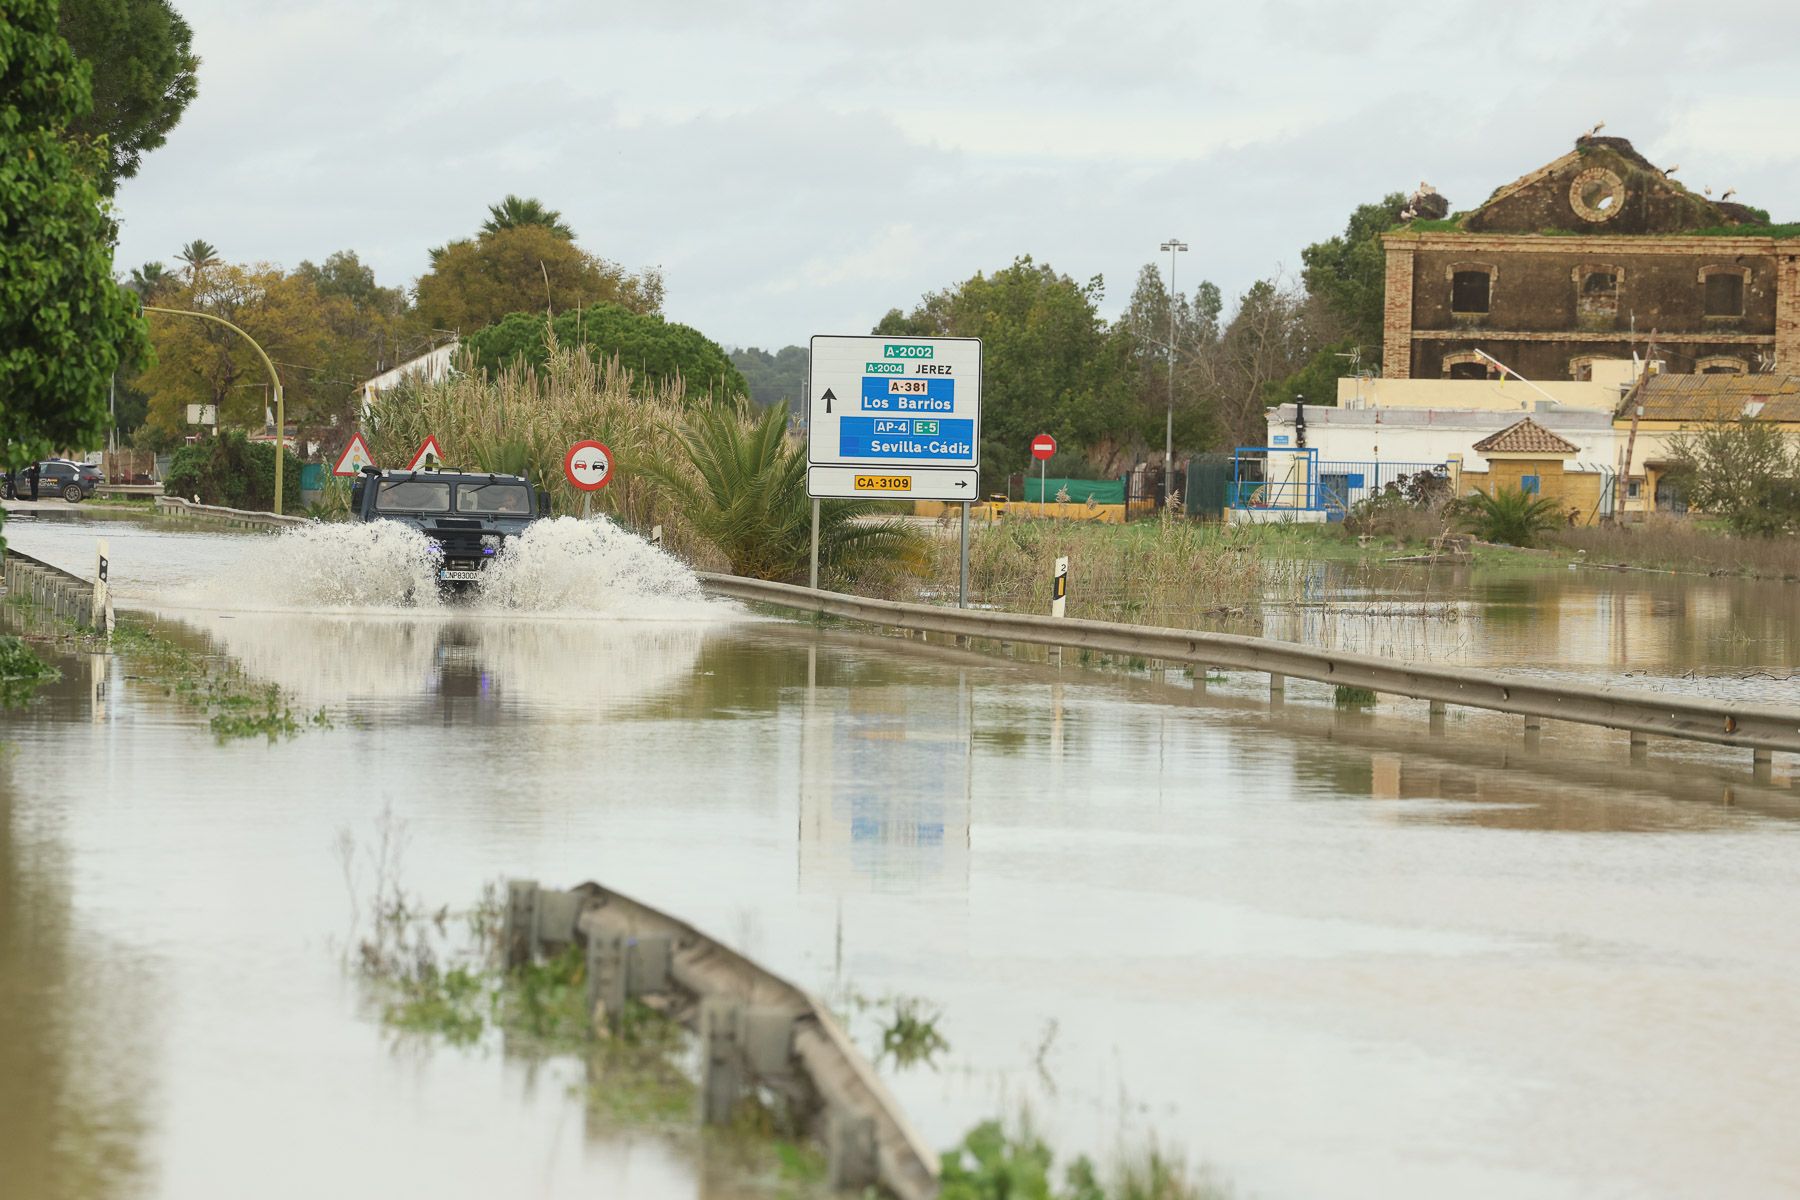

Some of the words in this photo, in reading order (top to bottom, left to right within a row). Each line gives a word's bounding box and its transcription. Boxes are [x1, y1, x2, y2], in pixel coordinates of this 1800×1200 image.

[886, 346, 932, 357] A-2002
[867, 364, 903, 373] A-2004
[916, 364, 952, 375] JEREZ
[891, 382, 926, 392] A-381
[864, 396, 889, 408] Los
[898, 397, 952, 410] Barrios
[877, 421, 907, 432] AP-4
[916, 422, 937, 433] E-5
[871, 440, 970, 454] Sevilla-Cádiz
[857, 478, 909, 488] CA-3109
[1061, 563, 1066, 571] 2
